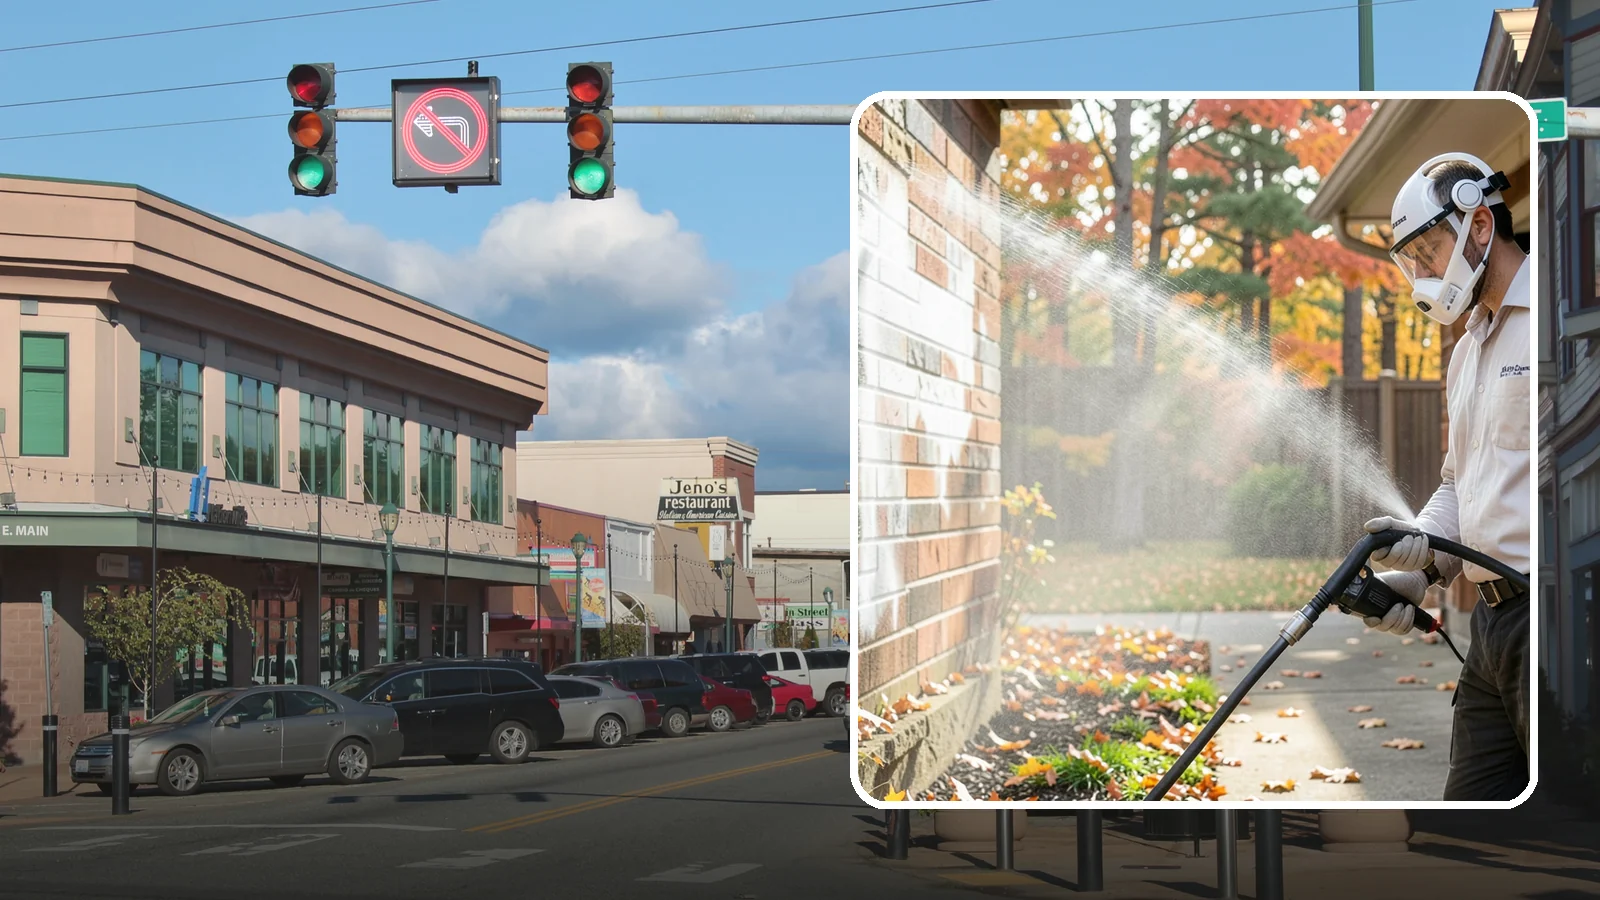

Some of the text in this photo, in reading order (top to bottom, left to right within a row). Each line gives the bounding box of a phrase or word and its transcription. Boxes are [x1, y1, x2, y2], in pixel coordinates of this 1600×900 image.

[670, 480, 728, 494] Jeno's
[665, 496, 731, 509] restaurant
[659, 510, 682, 519] Italian
[686, 510, 714, 519] American
[715, 510, 738, 519] Cuisine
[2, 525, 49, 536] E. MAIN
[797, 607, 829, 617] Street
